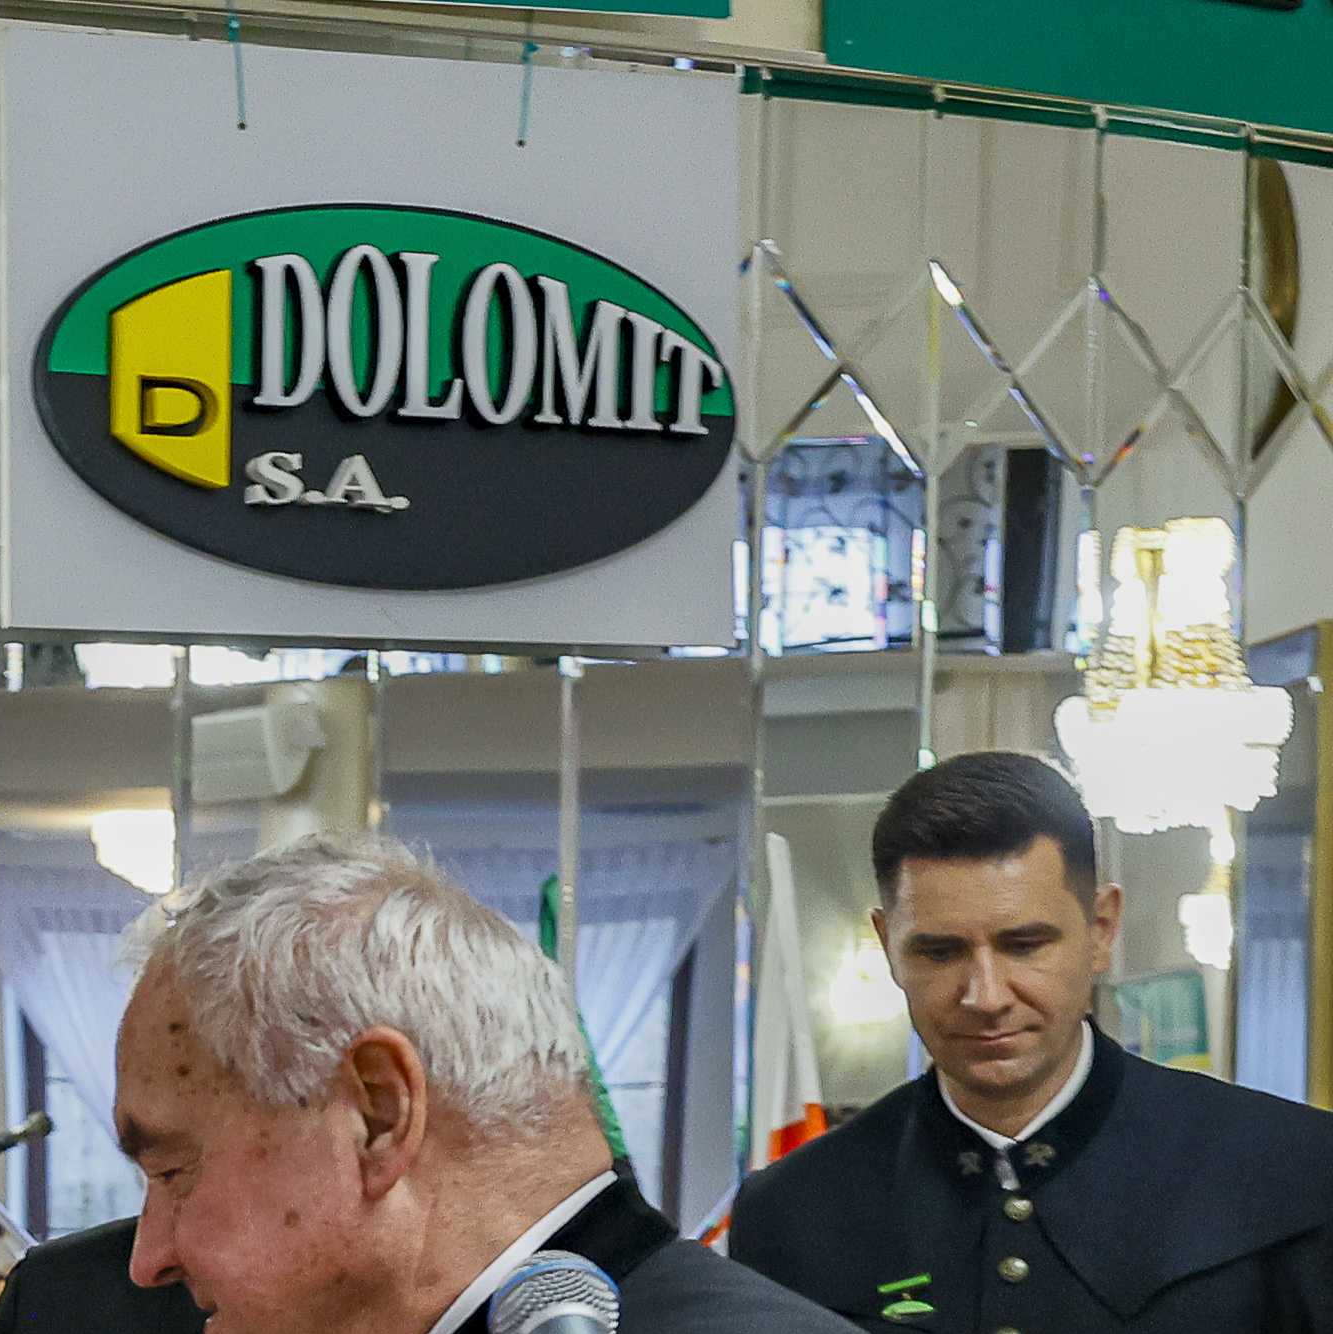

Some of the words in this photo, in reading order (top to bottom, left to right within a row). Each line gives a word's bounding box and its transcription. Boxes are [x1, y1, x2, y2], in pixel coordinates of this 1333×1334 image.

[253, 243, 724, 435] DOLOMIT
[137, 375, 219, 437] D
[244, 451, 410, 512] S.A.
